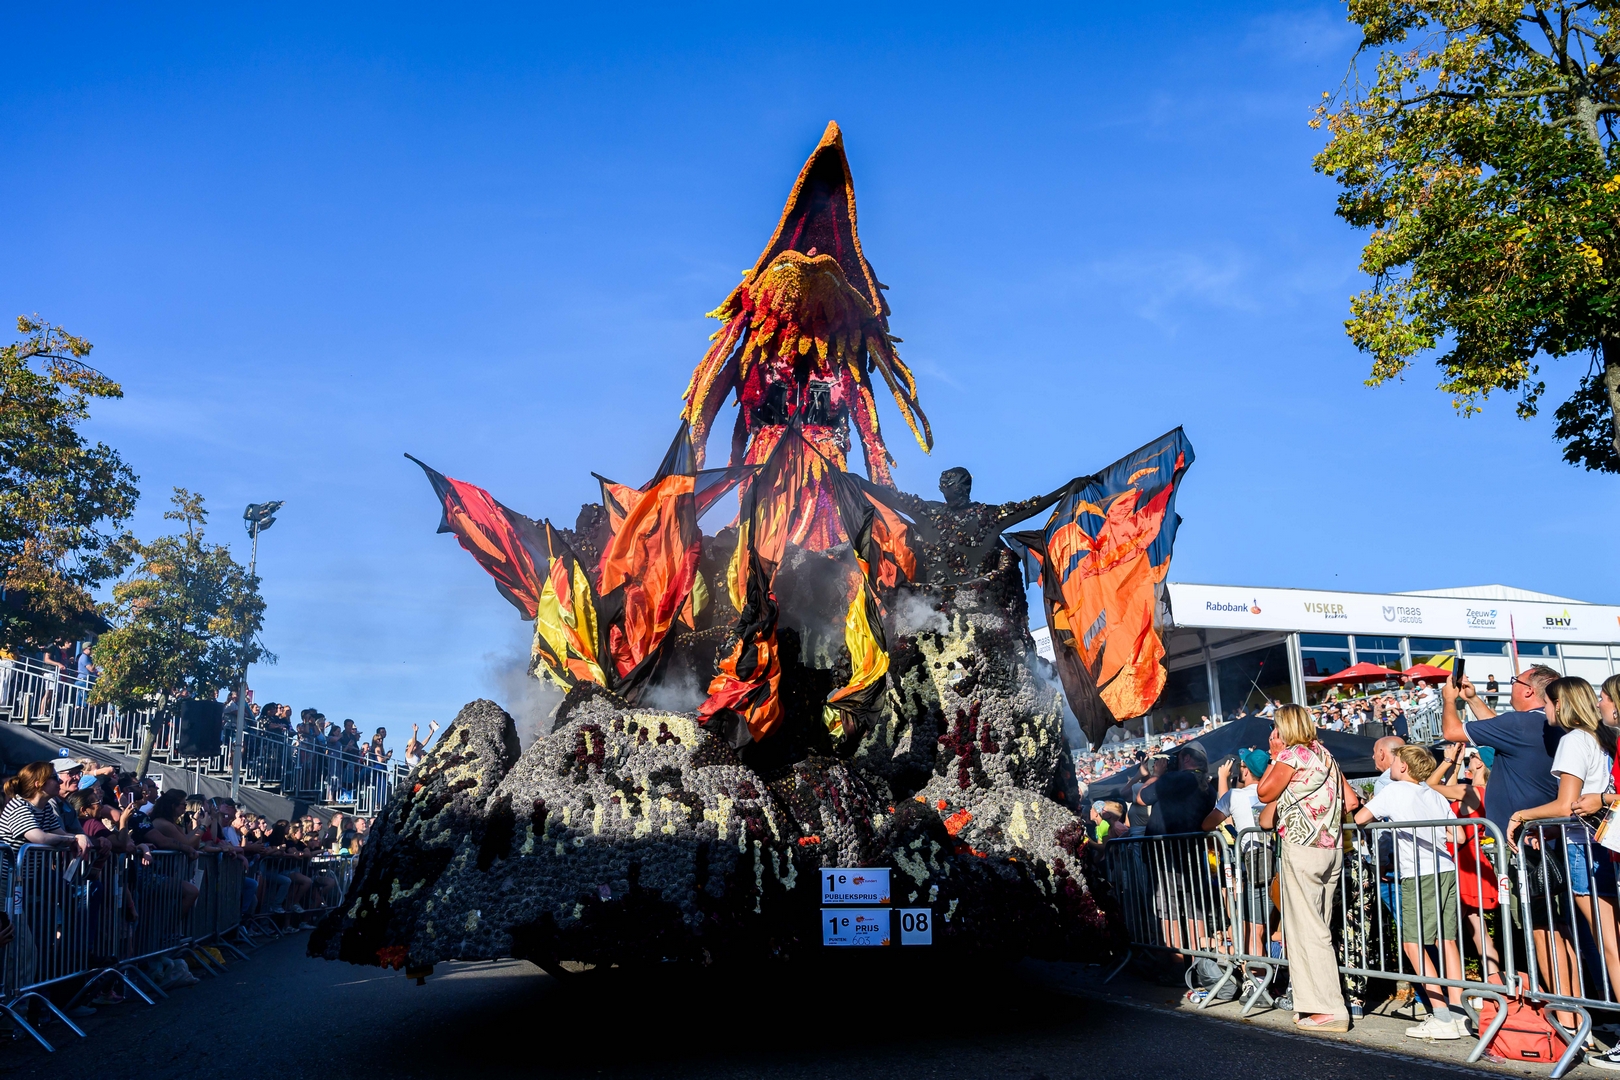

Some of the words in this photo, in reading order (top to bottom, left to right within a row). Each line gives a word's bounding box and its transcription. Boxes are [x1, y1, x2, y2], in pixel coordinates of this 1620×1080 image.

[1206, 601, 1249, 612] Rabobank
[1304, 602, 1344, 614] VISKER
[1397, 606, 1421, 616] maas
[1466, 608, 1490, 617] Zeeuw
[1472, 616, 1496, 625] Zeeuw
[1545, 617, 1571, 626] BHV
[902, 912, 929, 933] 08
[855, 924, 880, 932] PRIJS
[852, 935, 871, 946] 603
